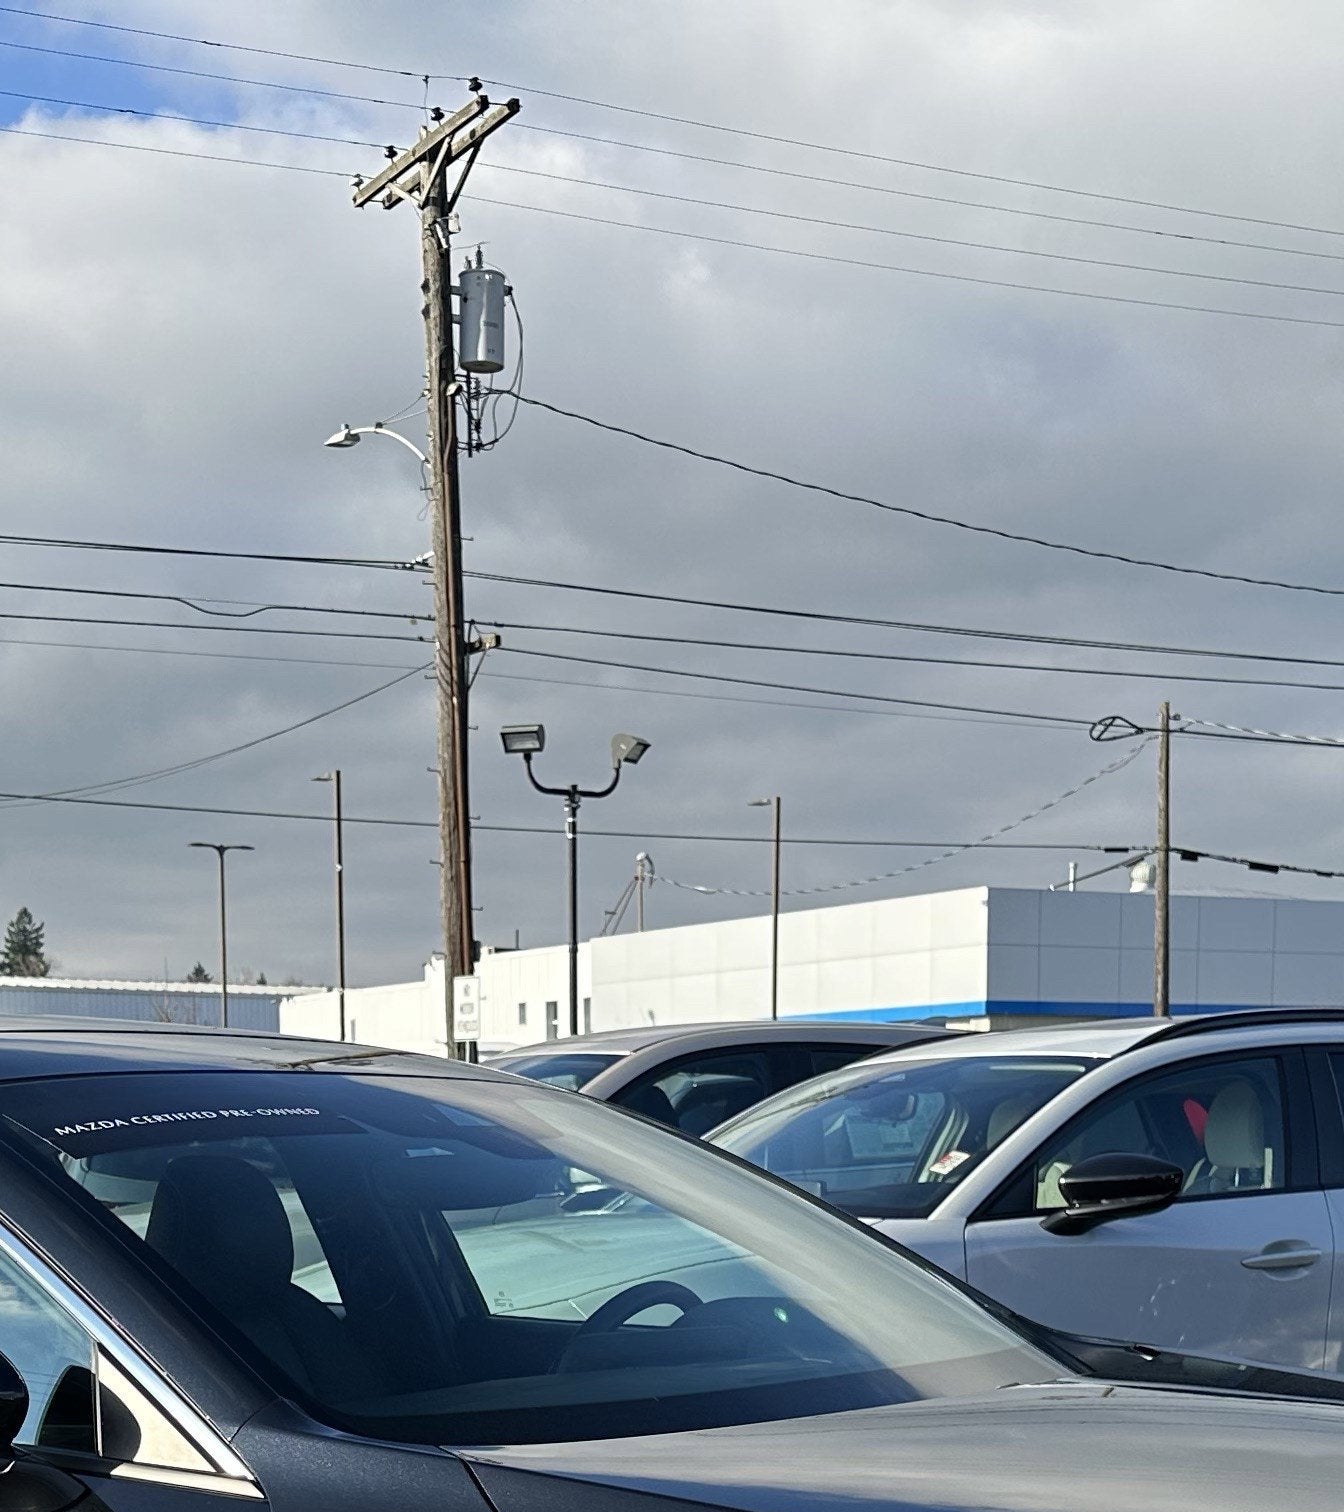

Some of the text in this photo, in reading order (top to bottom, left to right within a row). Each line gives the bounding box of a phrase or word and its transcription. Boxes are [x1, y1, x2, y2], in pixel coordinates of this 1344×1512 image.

[54, 1108, 320, 1136] MAZDA CERTIFIED PRE-OWNED
